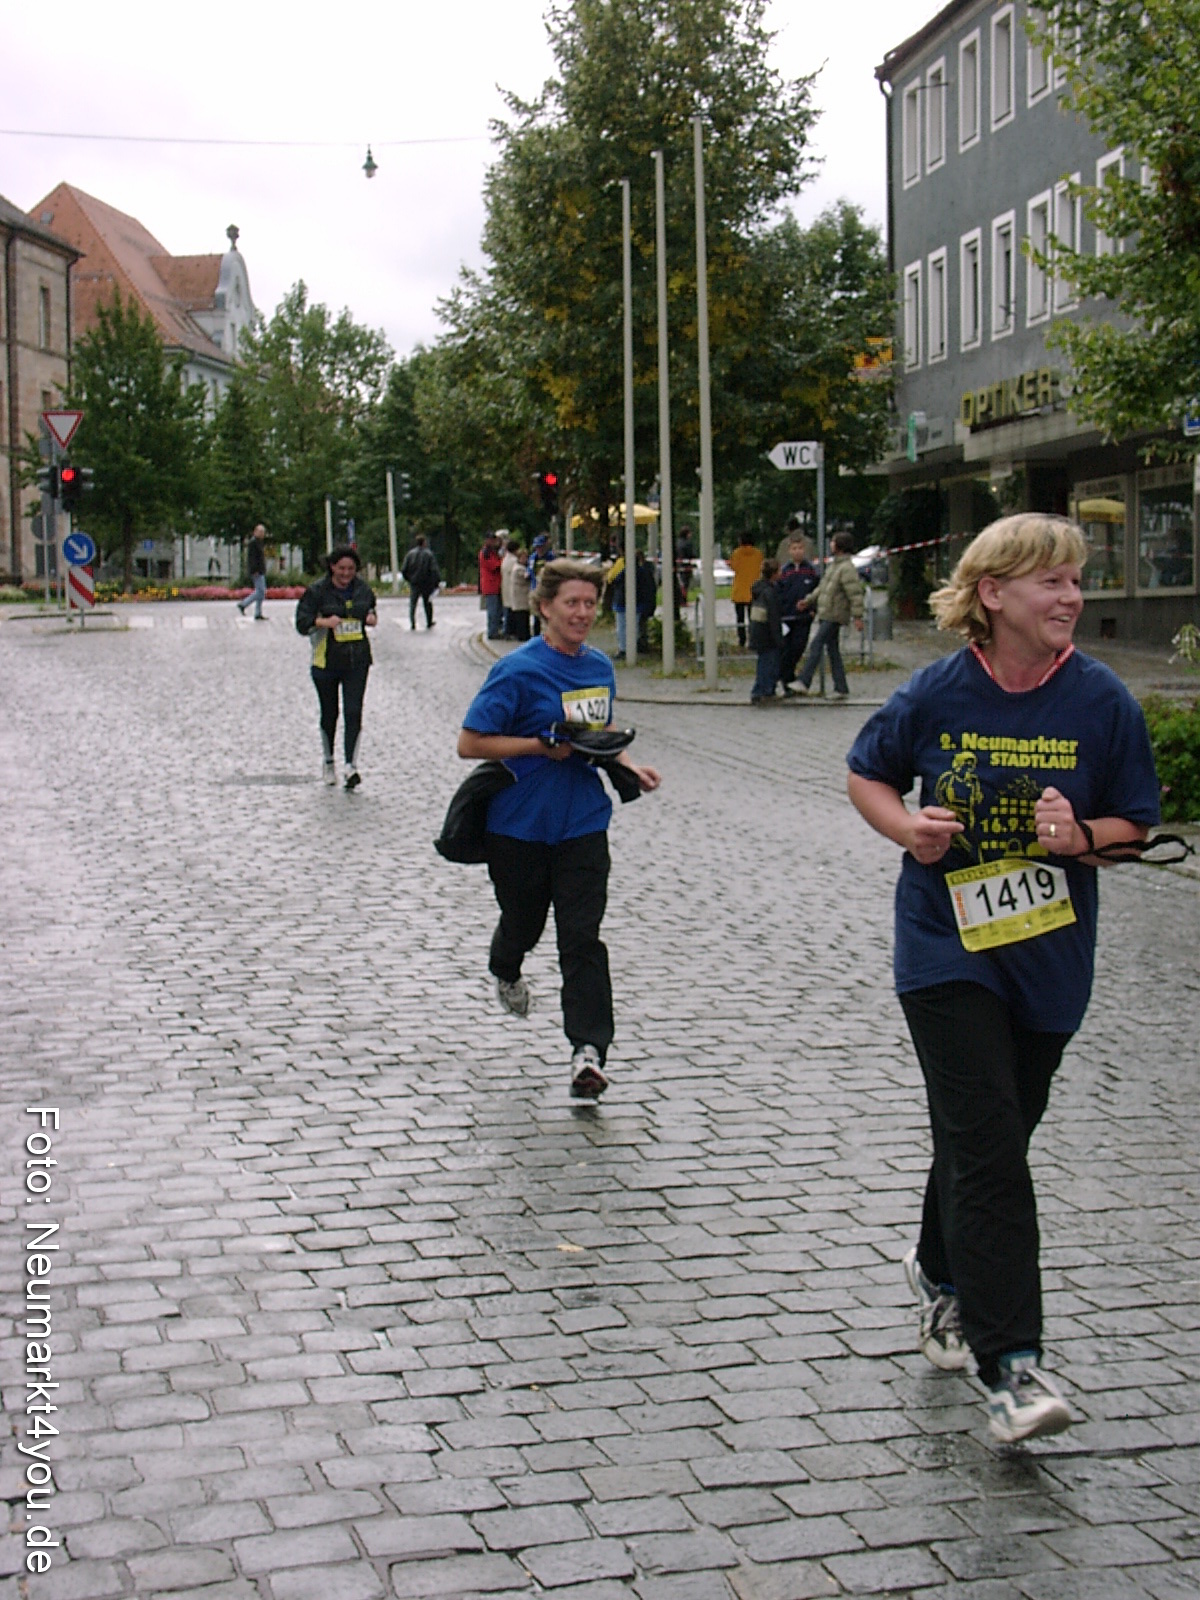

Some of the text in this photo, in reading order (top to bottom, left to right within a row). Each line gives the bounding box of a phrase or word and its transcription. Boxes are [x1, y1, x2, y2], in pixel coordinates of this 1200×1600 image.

[960, 366, 1052, 427] OPTIKER
[782, 445, 811, 466] WC
[961, 732, 1079, 753] Neumarkter
[990, 752, 1077, 770] STADTLAUF
[980, 817, 1036, 833] 16.9.2
[976, 867, 1056, 917] 1419
